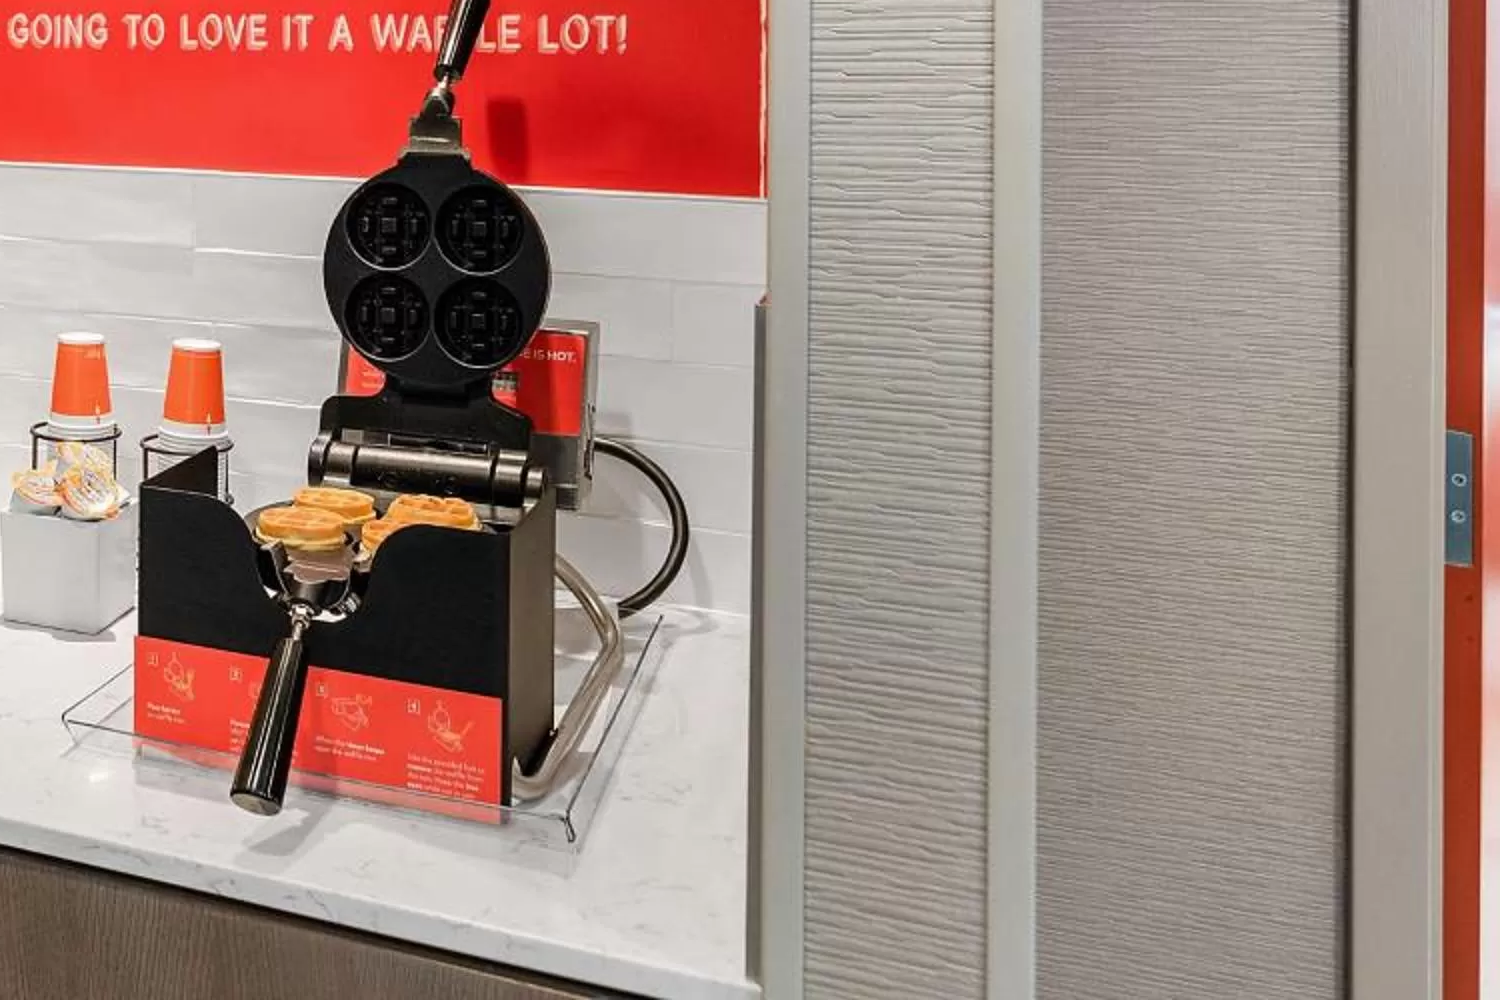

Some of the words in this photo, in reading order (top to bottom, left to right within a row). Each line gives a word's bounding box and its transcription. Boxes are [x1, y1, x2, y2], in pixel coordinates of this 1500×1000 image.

[5, 12, 109, 51] GOING
[123, 13, 167, 50] TO
[179, 13, 269, 51] LOVE
[281, 13, 313, 52] IT
[327, 15, 355, 54] A
[369, 14, 522, 56] WAFLE
[536, 13, 628, 56] LOT!
